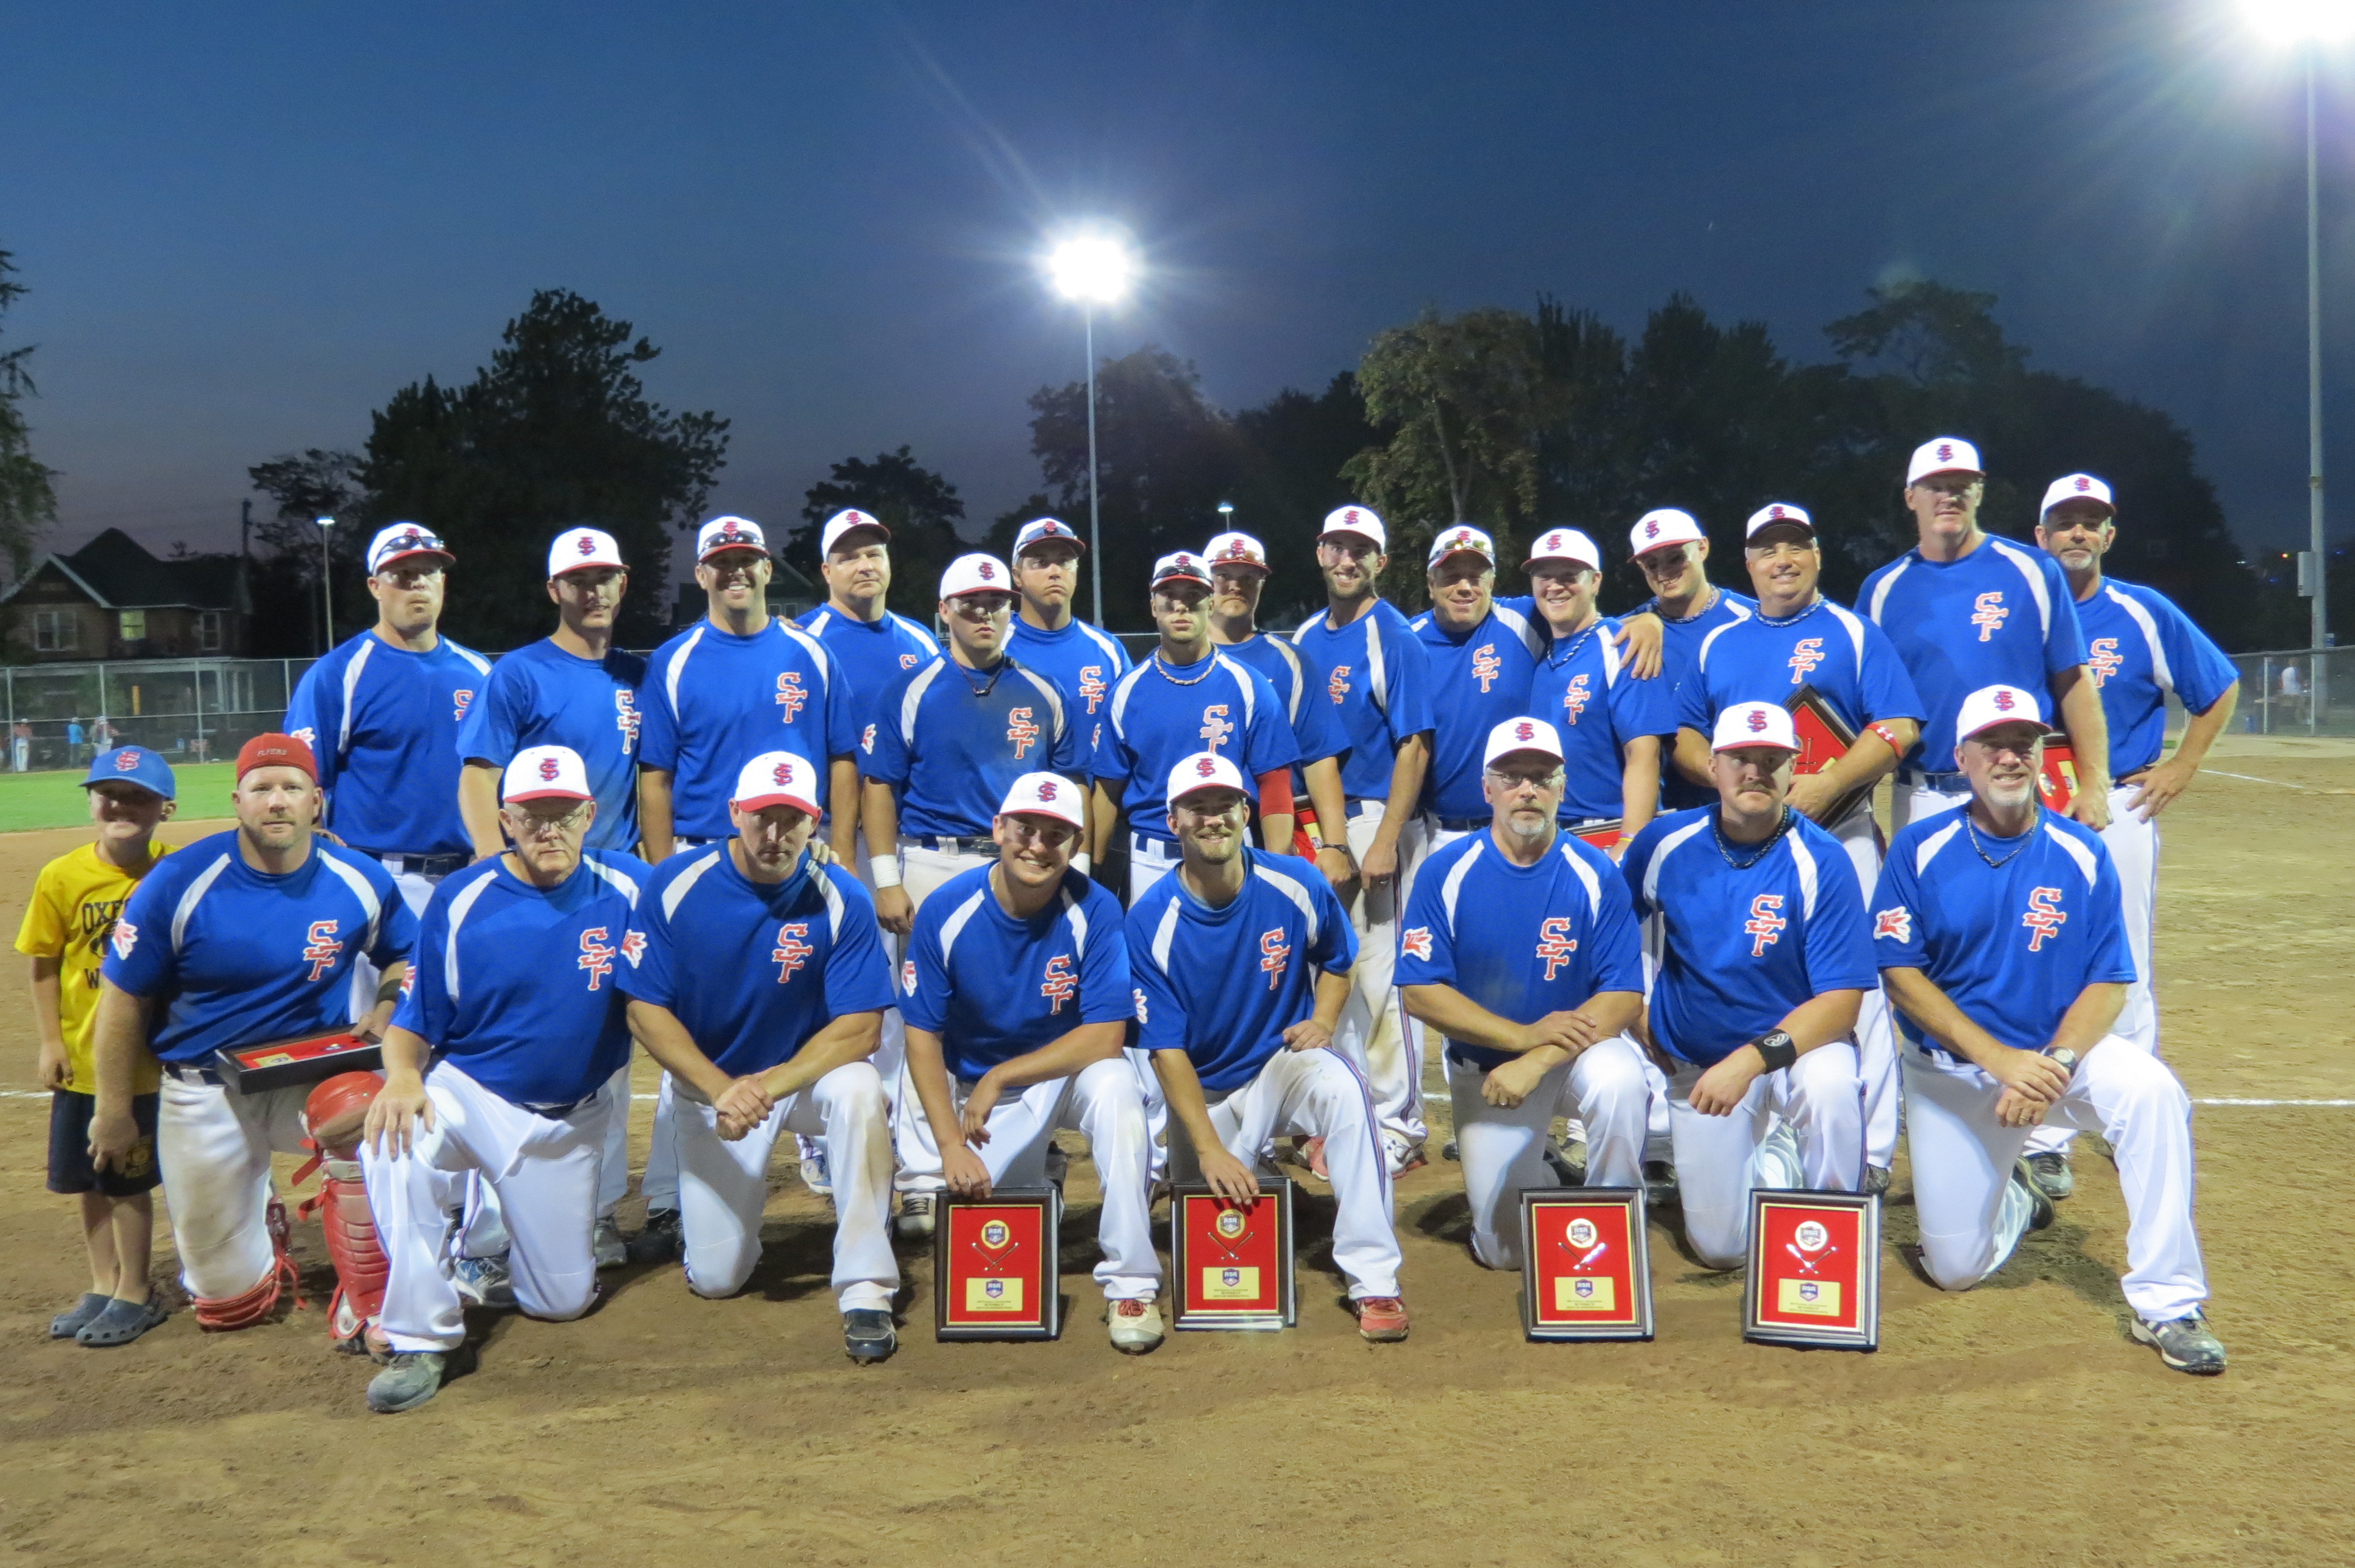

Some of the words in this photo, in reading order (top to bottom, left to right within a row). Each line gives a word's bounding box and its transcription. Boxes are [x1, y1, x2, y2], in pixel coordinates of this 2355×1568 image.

[1972, 592, 2008, 641] SF
[1472, 644, 1500, 693] SF
[1789, 639, 1824, 684] SF
[2089, 639, 2122, 687] SF
[777, 673, 807, 723] SF
[1080, 667, 1106, 713] SF
[1564, 675, 1590, 725] SF
[616, 690, 641, 754] SF
[1008, 708, 1039, 759] SF
[82, 898, 130, 934] OXF
[1746, 895, 1785, 956] SF
[2022, 887, 2066, 952] SF
[304, 921, 343, 981] SF
[579, 928, 615, 990] SF
[772, 924, 812, 983] SF
[1261, 928, 1289, 990] SF
[1537, 918, 1577, 980] SF
[1041, 955, 1077, 1014] SF
